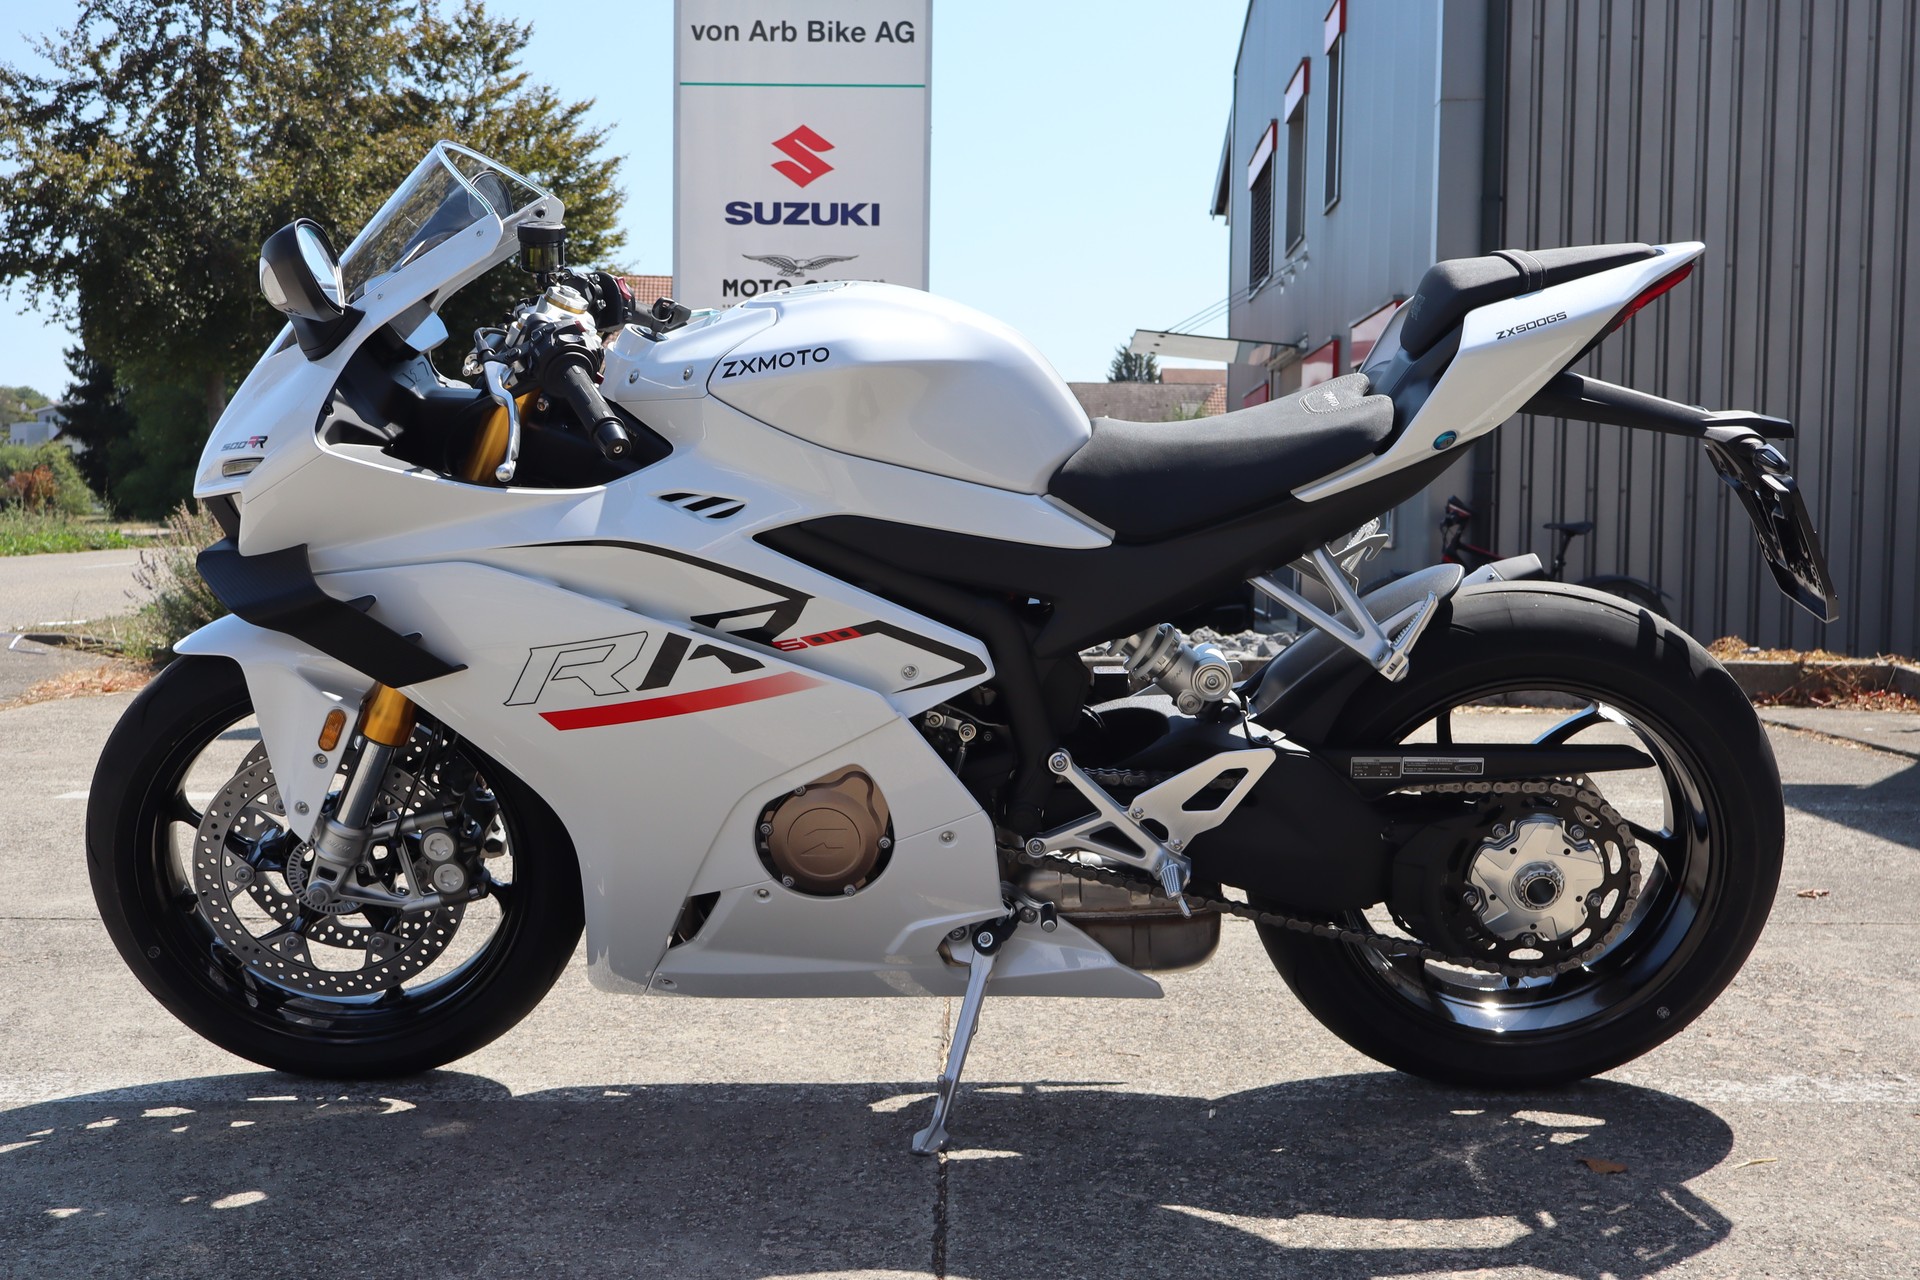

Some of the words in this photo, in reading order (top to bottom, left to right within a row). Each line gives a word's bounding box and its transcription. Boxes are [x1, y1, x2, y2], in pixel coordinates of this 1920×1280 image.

[691, 24, 740, 42] von
[748, 20, 798, 42] Arb
[807, 20, 867, 43] Bike
[874, 20, 915, 43] AG
[724, 201, 881, 227] SUZUKI
[721, 346, 831, 379] ZXMOTO
[772, 627, 863, 652] 500
